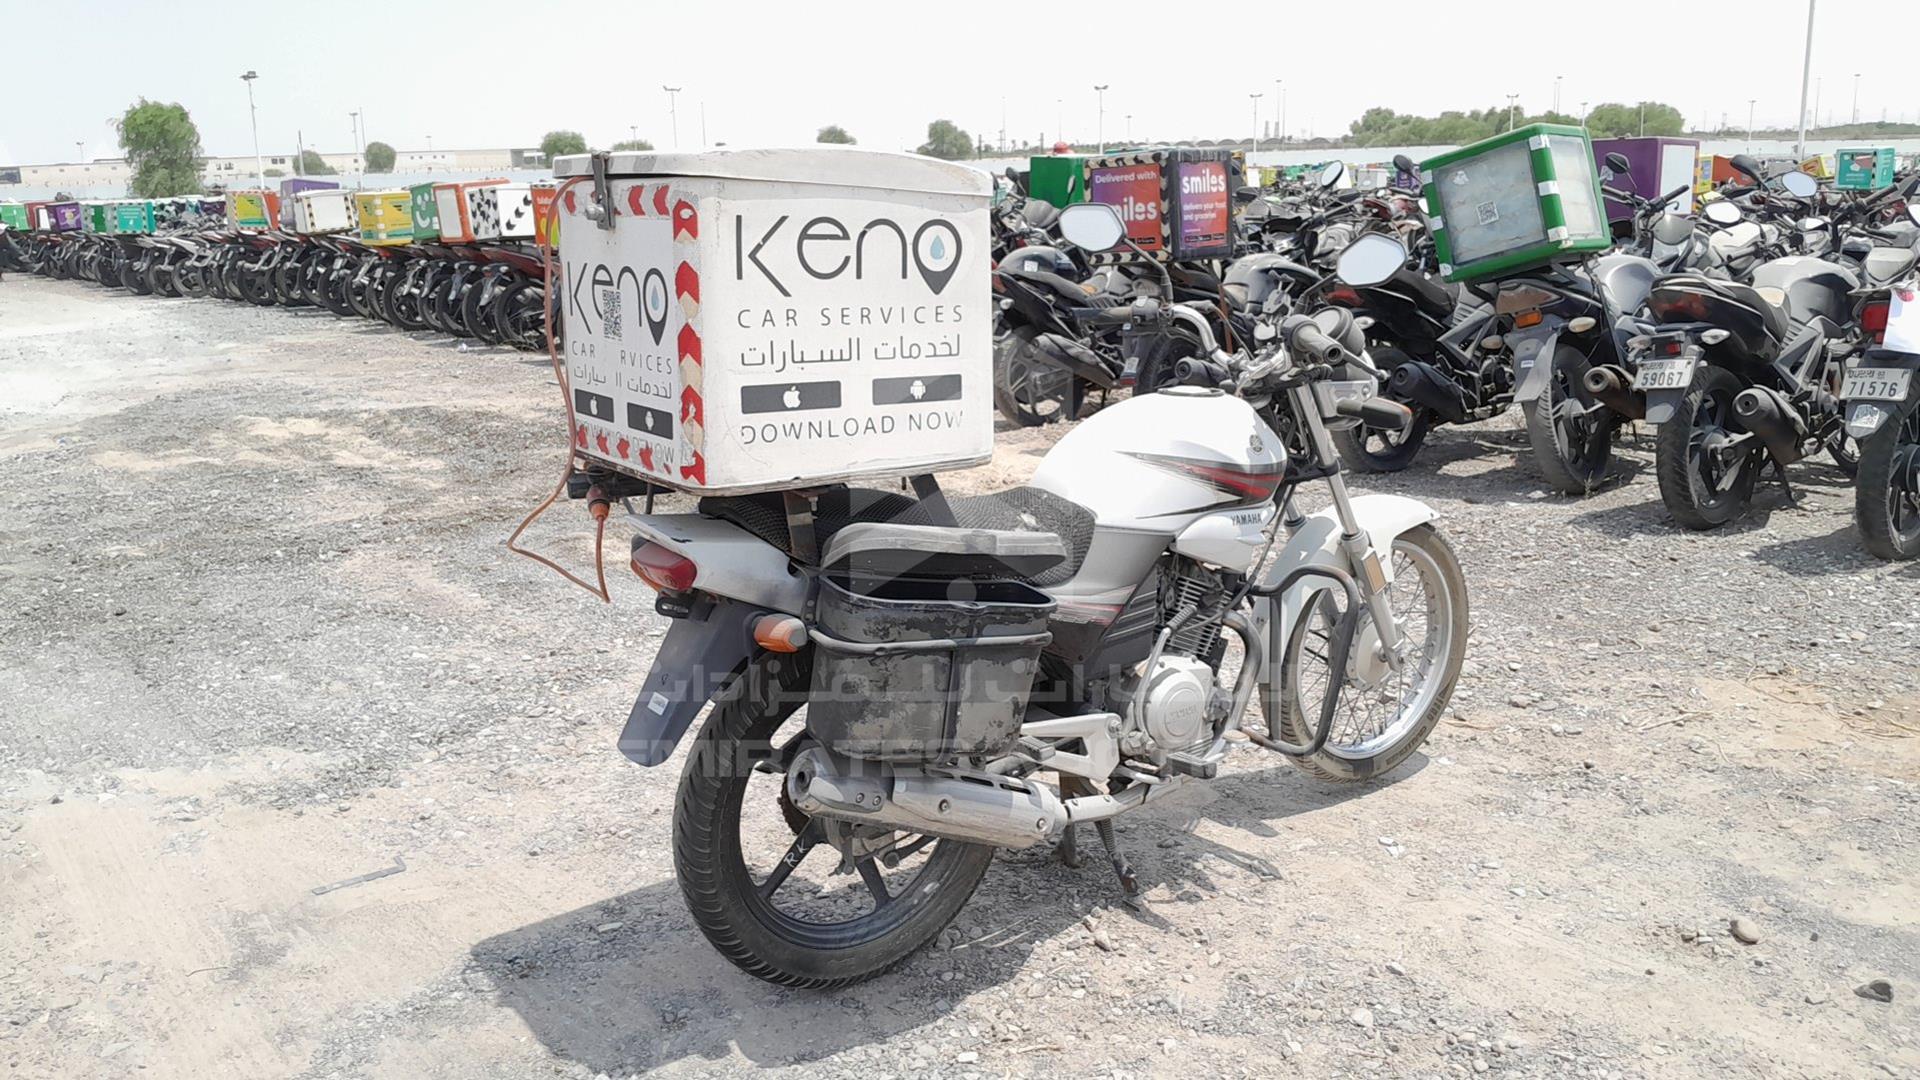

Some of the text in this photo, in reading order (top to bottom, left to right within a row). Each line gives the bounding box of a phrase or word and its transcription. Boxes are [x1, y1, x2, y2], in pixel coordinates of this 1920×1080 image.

[1095, 170, 1157, 184] Delivered with
[1182, 168, 1226, 194] smiles
[737, 305, 962, 329] CAR SERVICES
[572, 340, 596, 358] CAR
[874, 333, 960, 361] لخدمات
[1641, 371, 1683, 386] 59067
[1848, 381, 1898, 397] 71576
[740, 410, 964, 445] DOWNLOAD NOW
[1231, 512, 1263, 526] YAMAHA
